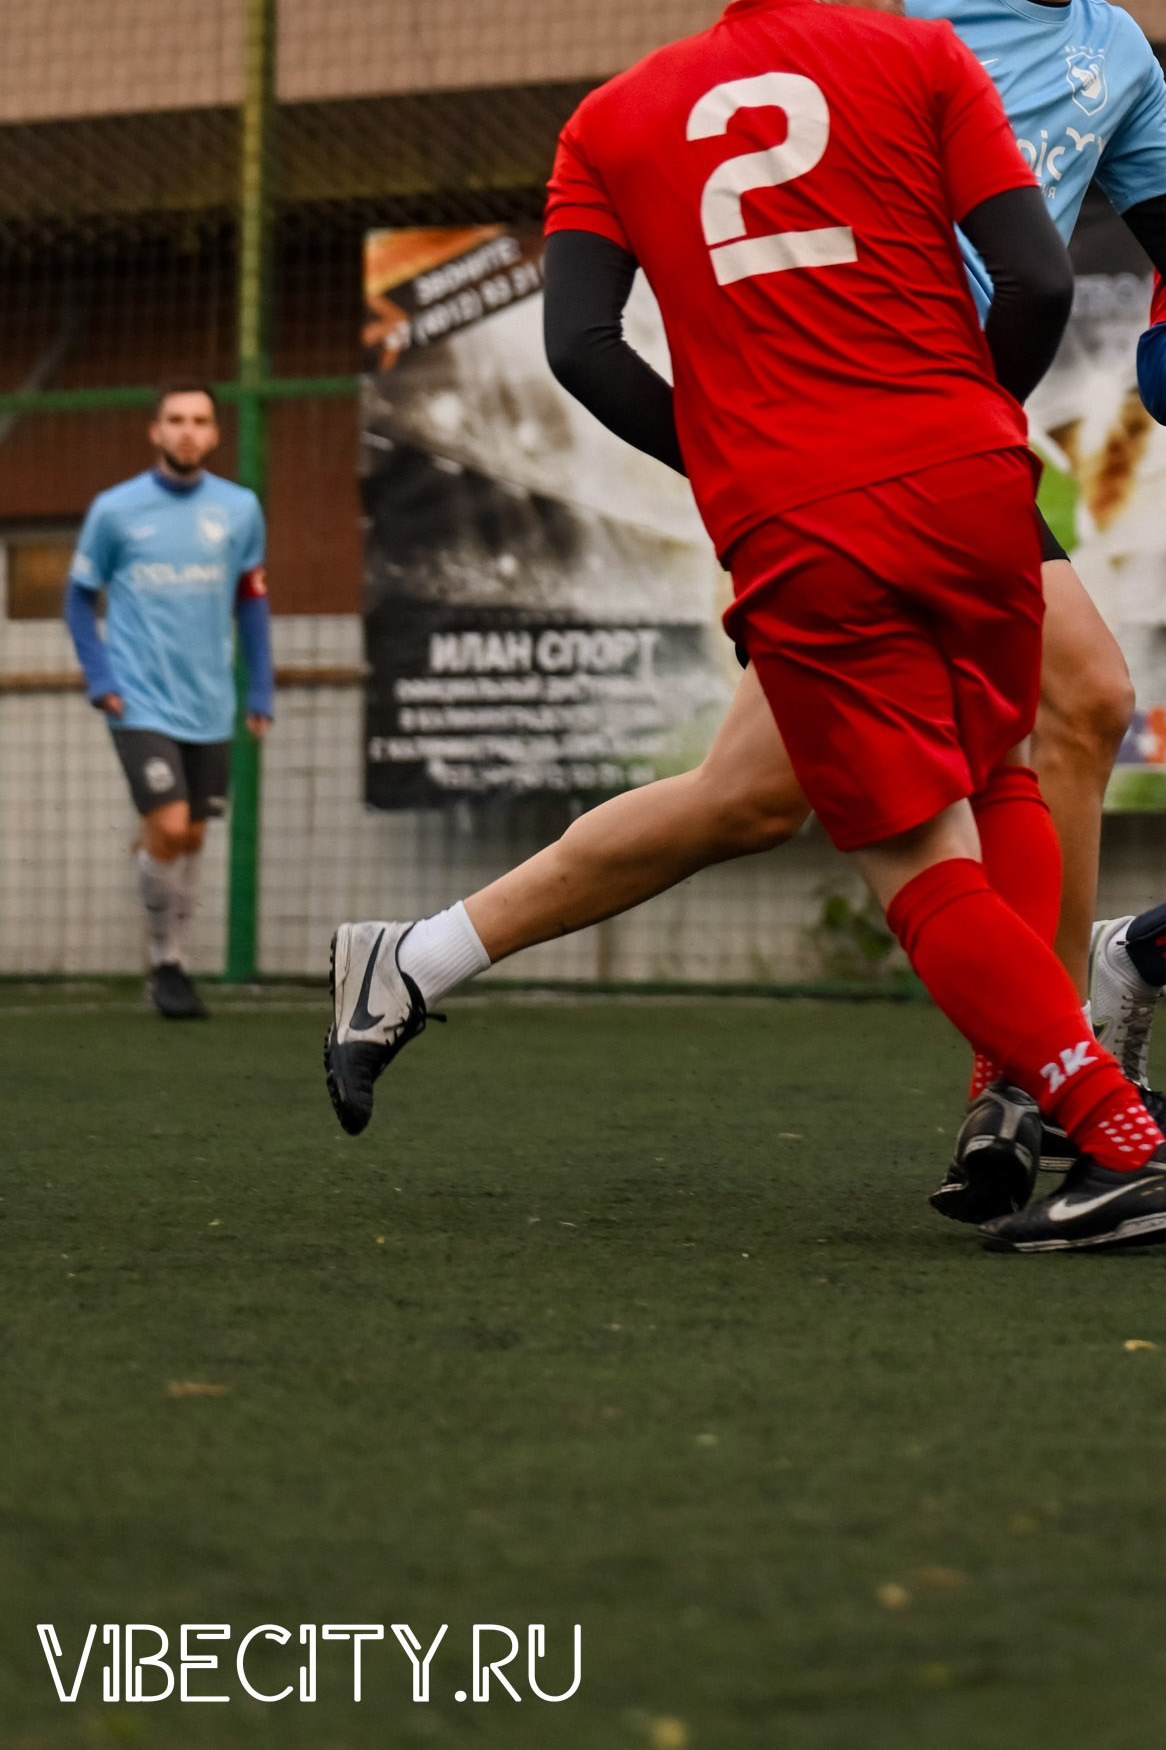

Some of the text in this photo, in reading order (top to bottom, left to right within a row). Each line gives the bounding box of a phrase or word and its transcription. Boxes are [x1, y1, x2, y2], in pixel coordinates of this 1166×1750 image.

[686, 72, 858, 286] 2
[431, 629, 660, 676] ИЛАН СПОРТ
[1040, 1041, 1099, 1094] 2K
